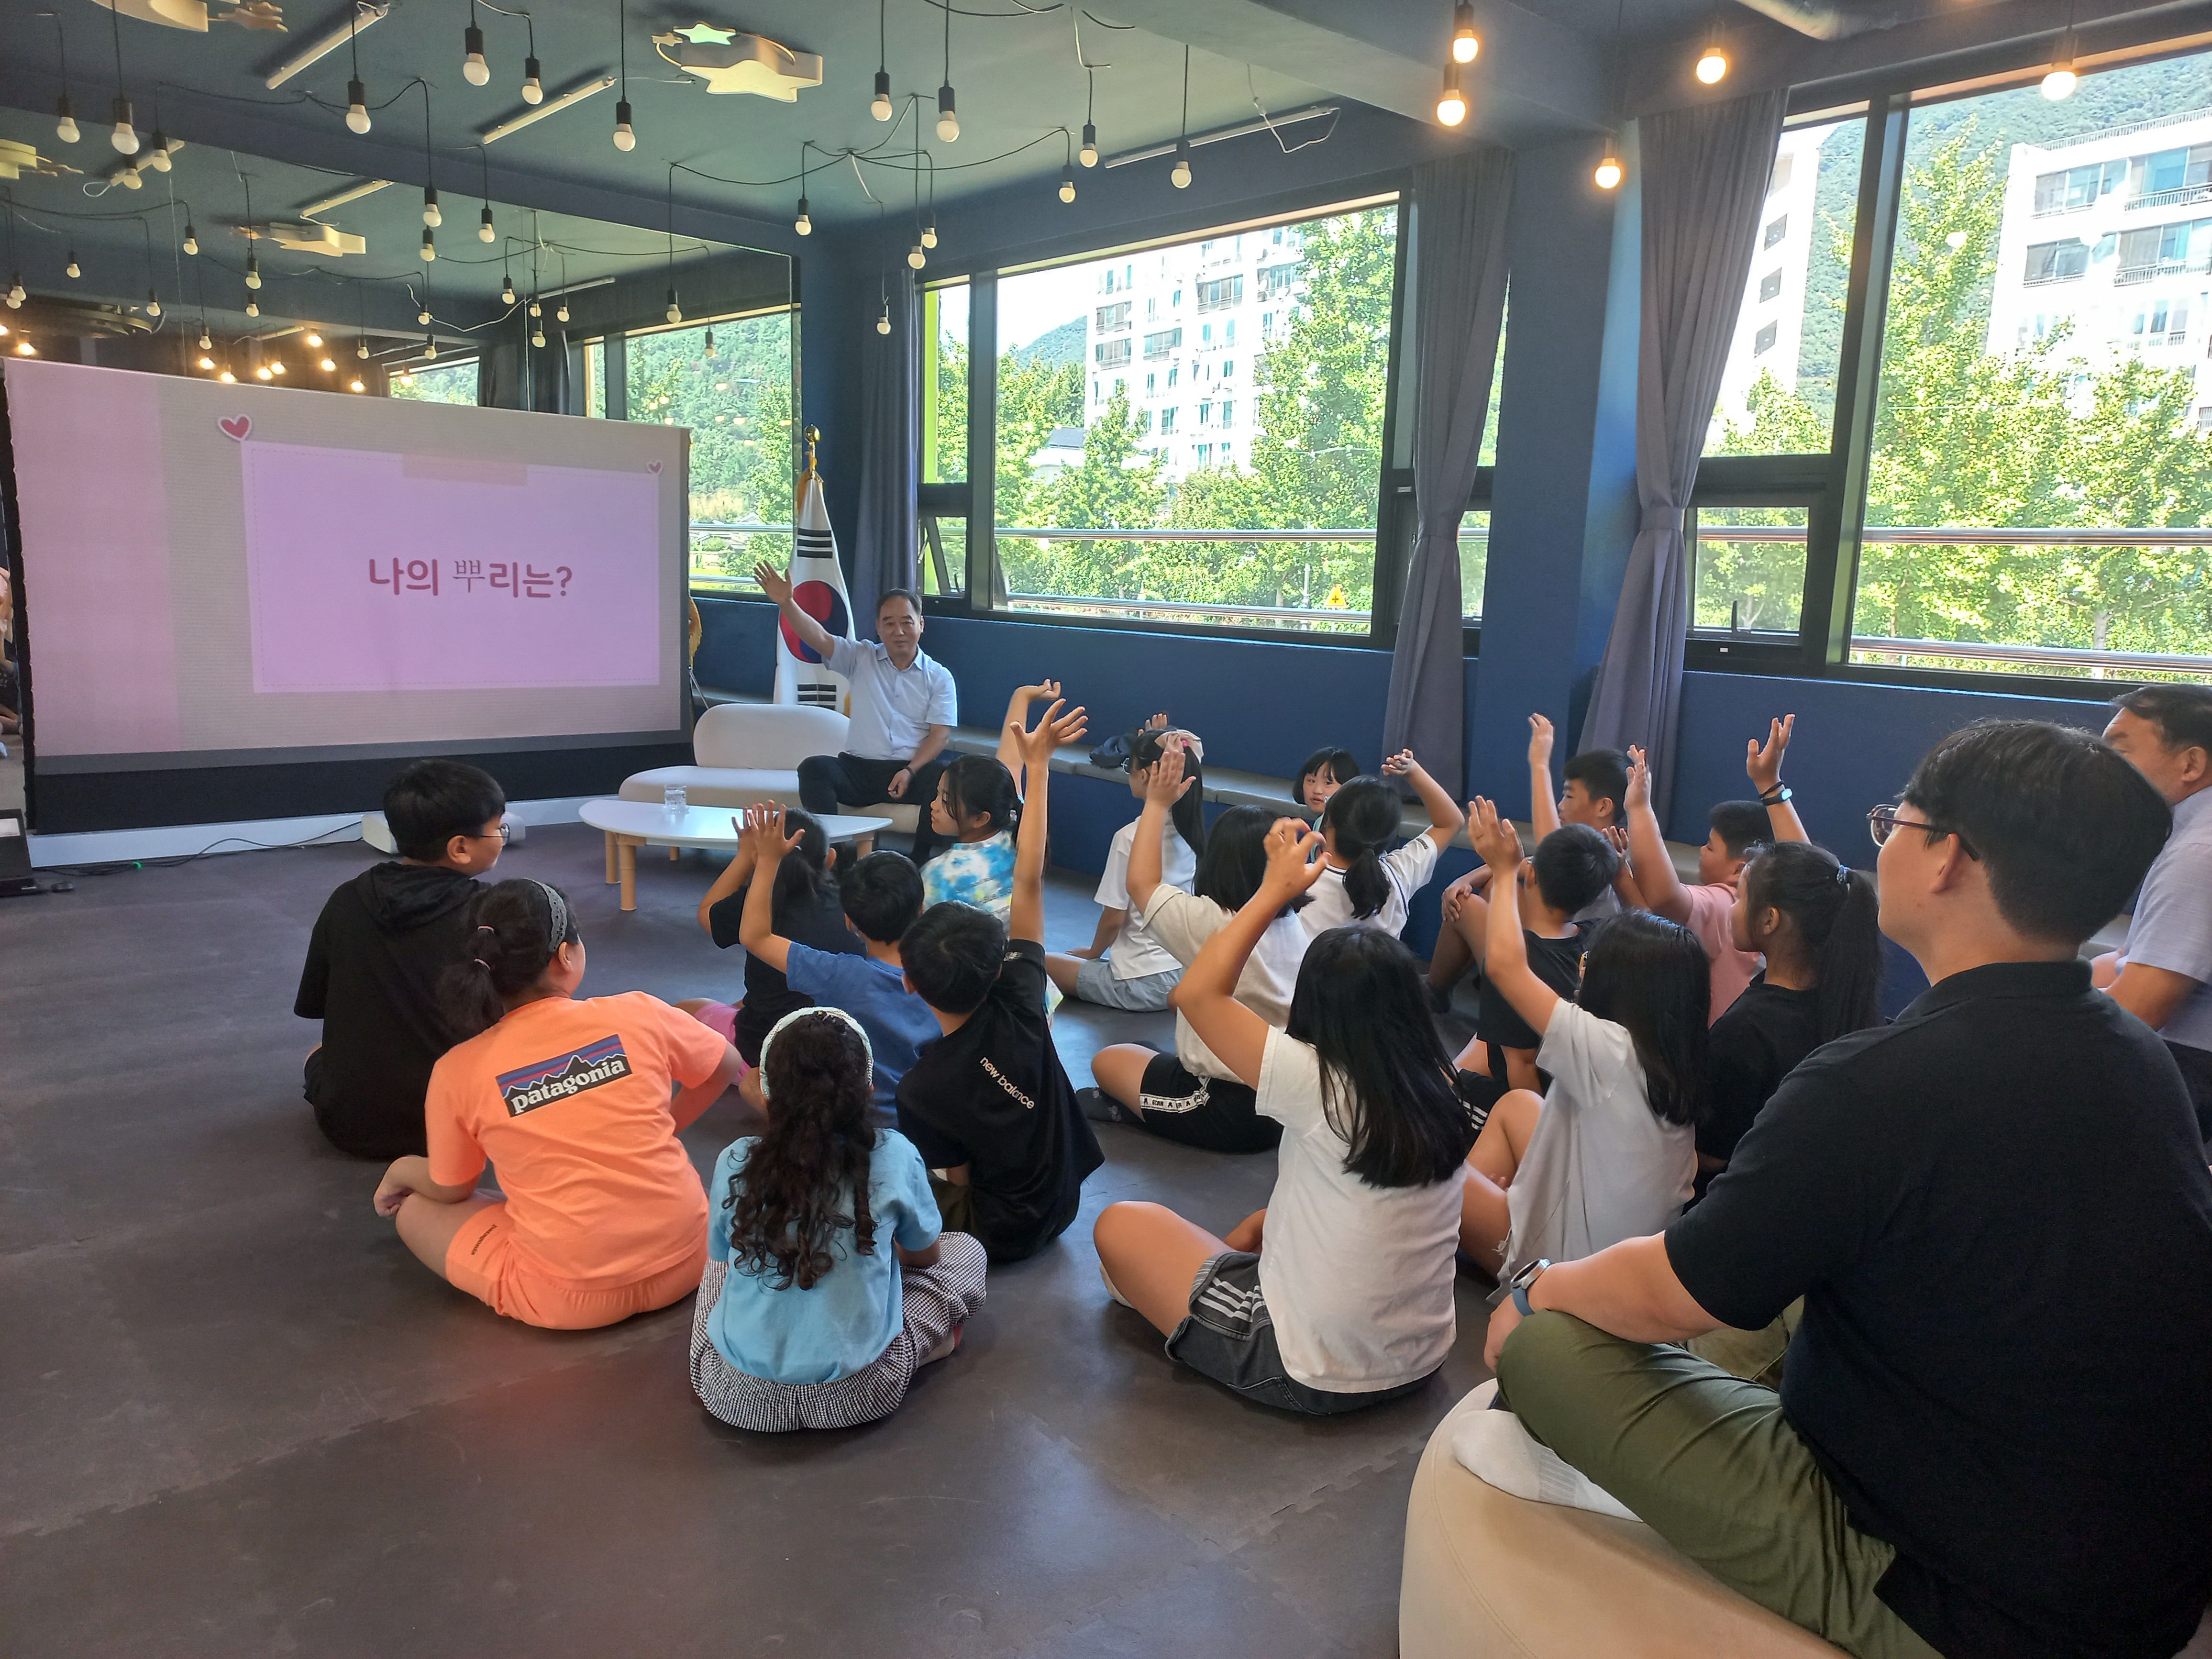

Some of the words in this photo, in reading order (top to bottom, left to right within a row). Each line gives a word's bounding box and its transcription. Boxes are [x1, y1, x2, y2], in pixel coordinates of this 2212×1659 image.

[369, 557, 438, 596] 나의
[453, 559, 573, 598] 뿌리는?
[511, 1060, 626, 1115] patagonia
[980, 1057, 1000, 1078] new
[996, 1075, 1035, 1109] balance
[471, 1224, 498, 1255] patagonia
